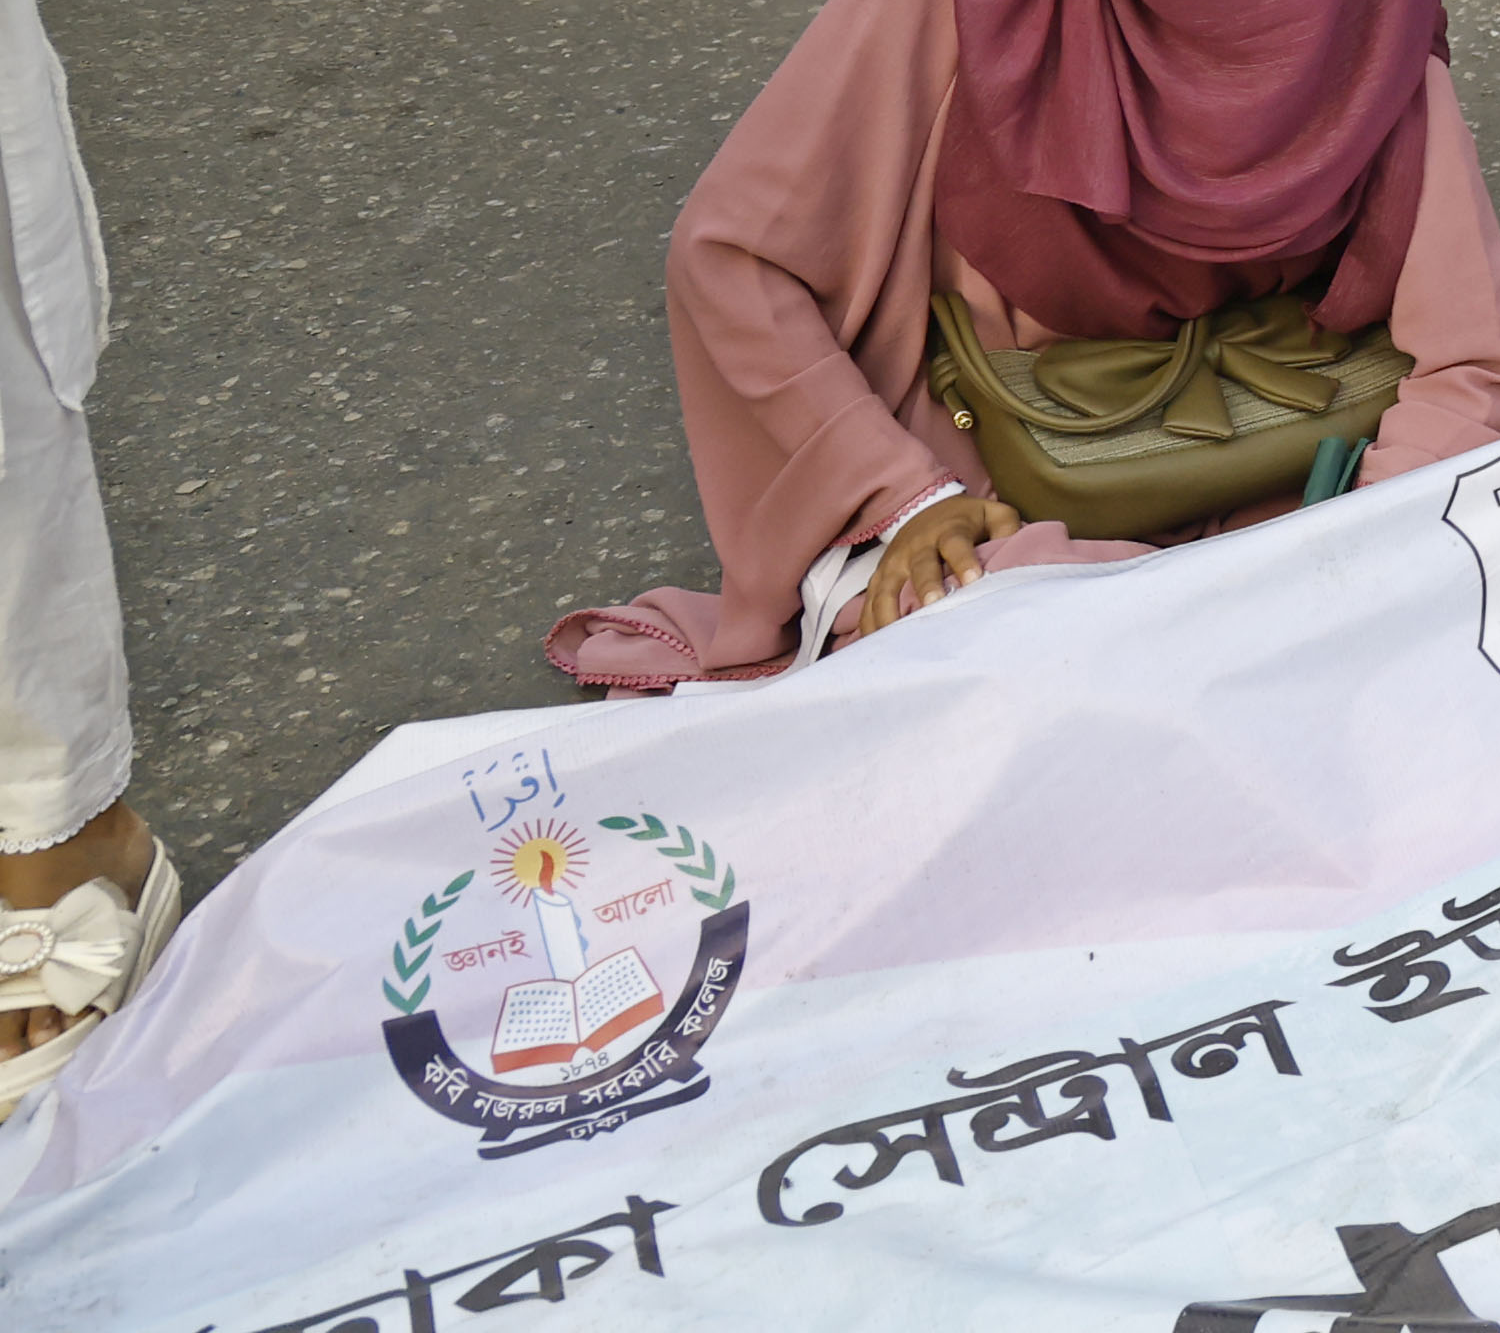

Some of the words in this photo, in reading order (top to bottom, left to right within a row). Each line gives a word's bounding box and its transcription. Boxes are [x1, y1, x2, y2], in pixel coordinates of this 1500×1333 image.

[441, 930, 534, 973] জ্ঞানই
[592, 878, 676, 926] আলো
[421, 1053, 471, 1106] কবি
[472, 1089, 567, 1123] নজরুল
[578, 1041, 681, 1107] সরকারি
[676, 956, 735, 1038] কলেজ
[565, 1108, 630, 1141] ঢাকা
[757, 998, 1303, 1227] সেন্ট্রাল
